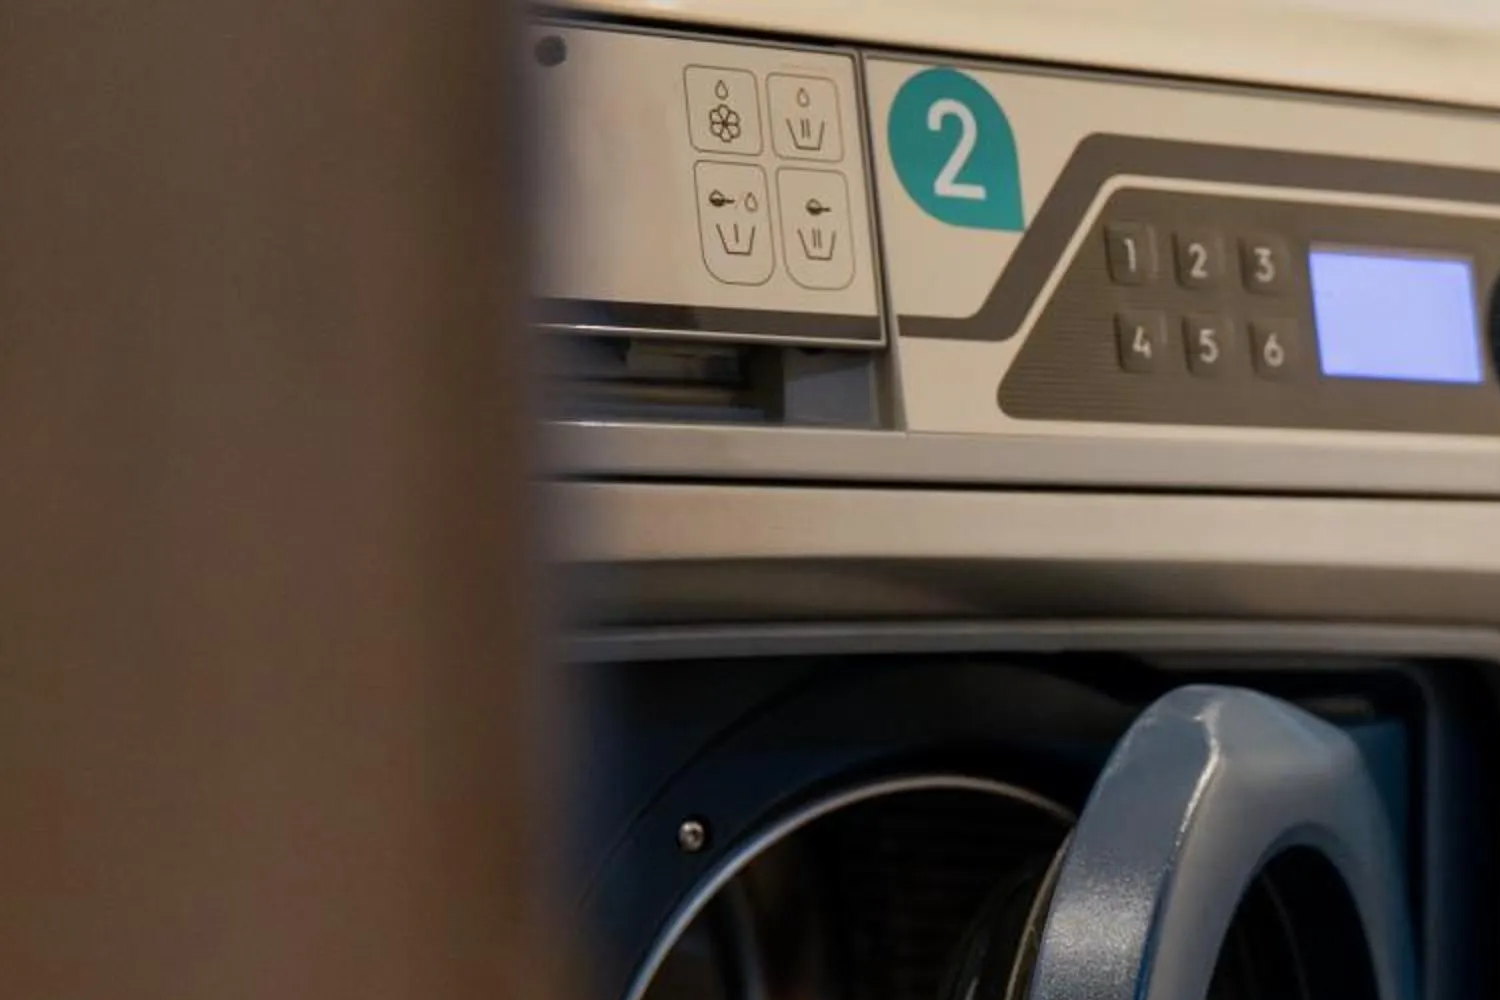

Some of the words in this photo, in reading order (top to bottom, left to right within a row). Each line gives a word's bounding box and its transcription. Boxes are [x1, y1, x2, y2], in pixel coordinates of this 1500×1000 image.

[927, 97, 987, 201] 2
[1123, 237, 1137, 272] 1
[1188, 242, 1209, 279] 2
[1253, 247, 1276, 283] 3
[1132, 325, 1153, 360] 4
[1199, 327, 1220, 364] 5
[1263, 332, 1285, 368] 6
